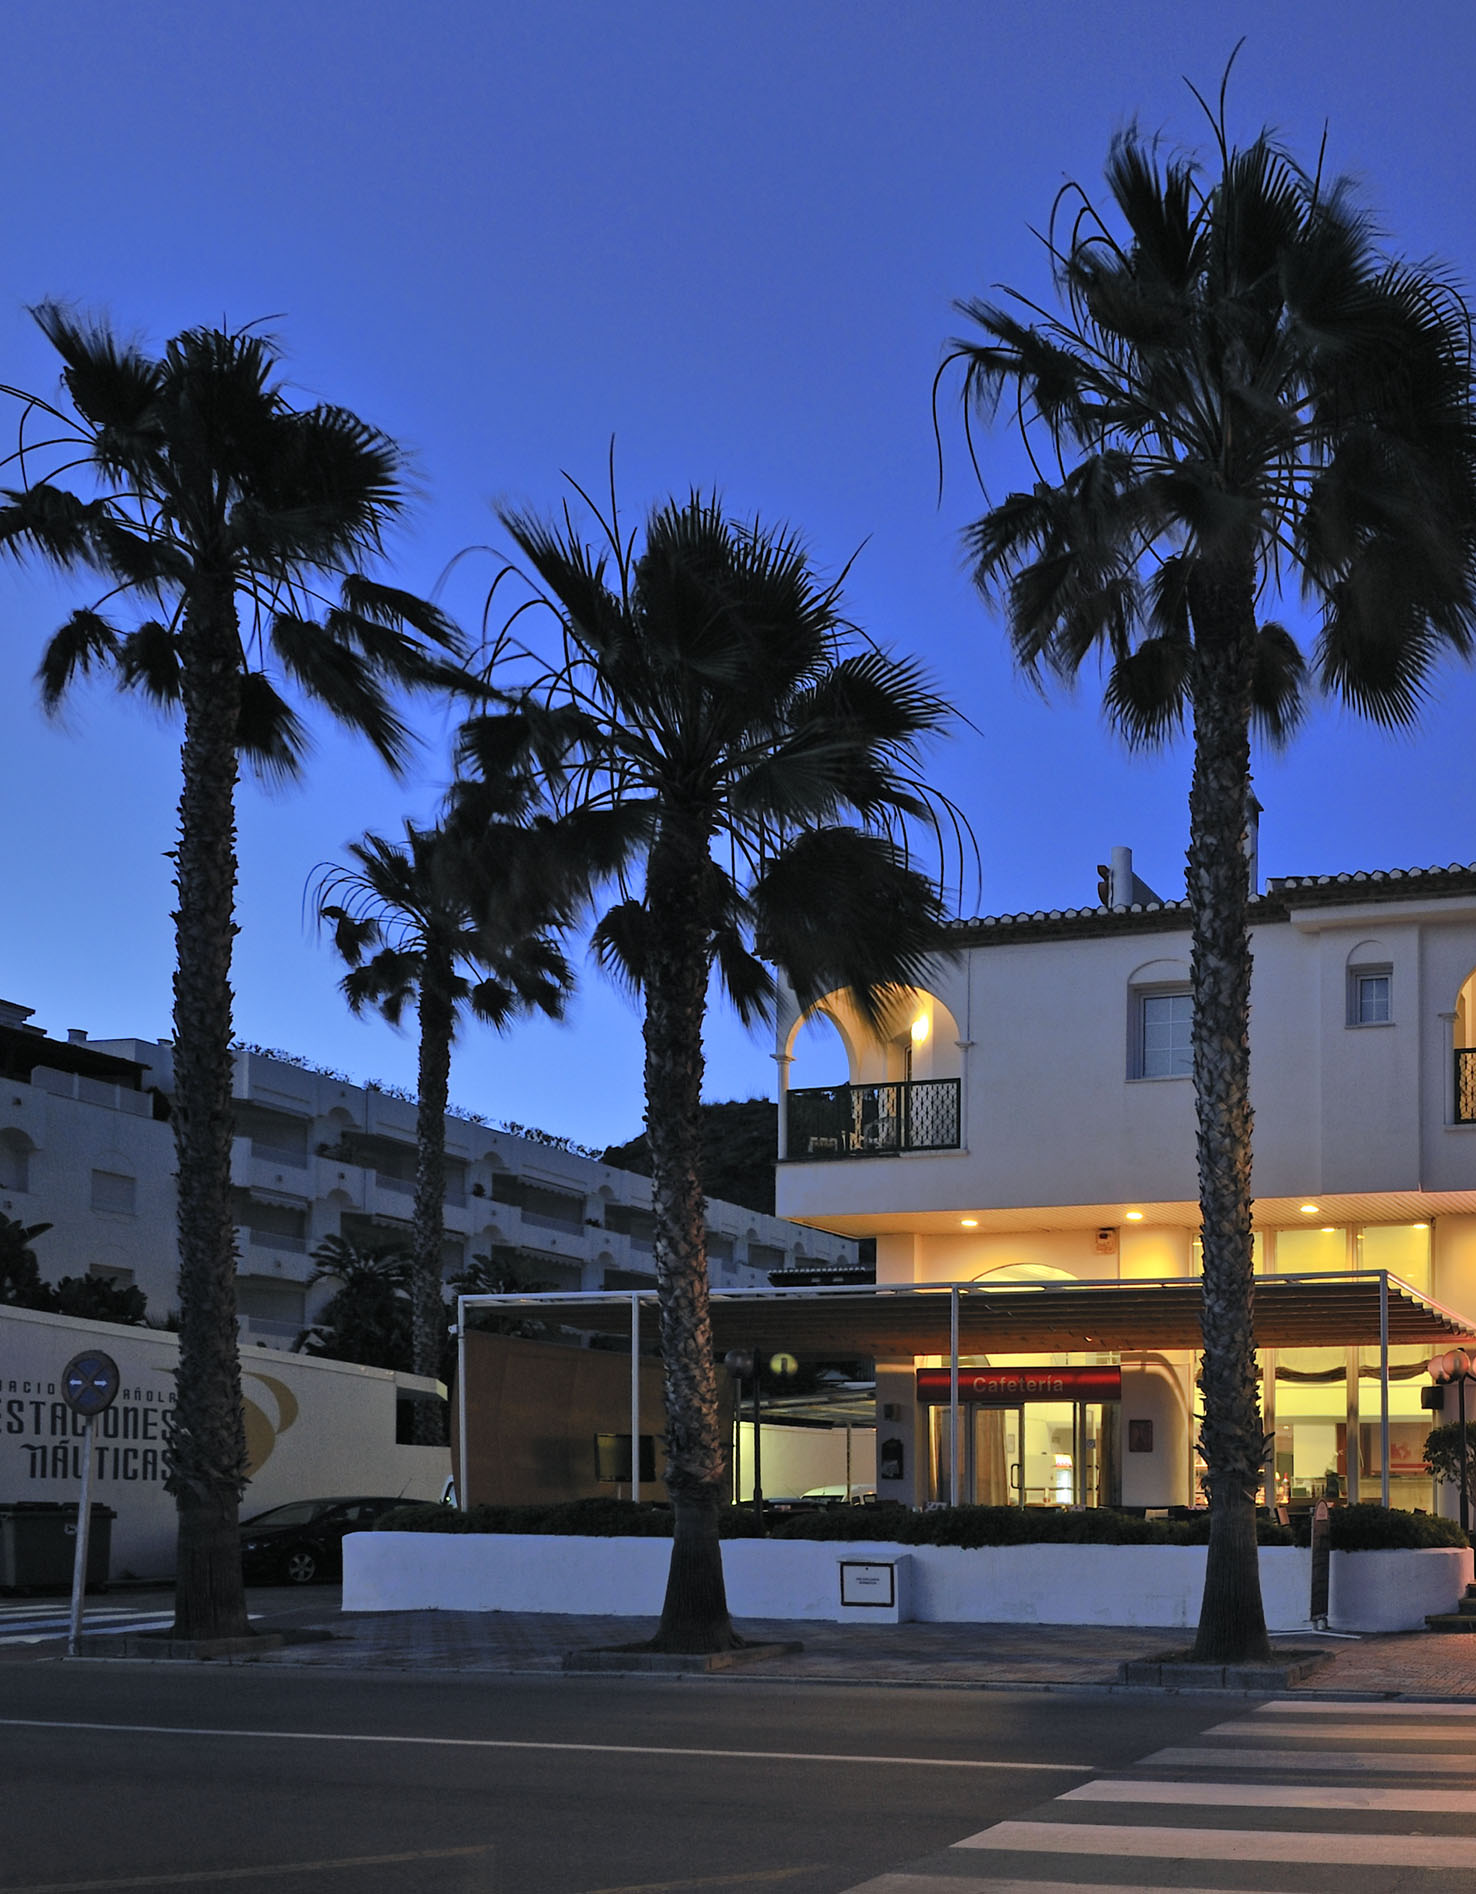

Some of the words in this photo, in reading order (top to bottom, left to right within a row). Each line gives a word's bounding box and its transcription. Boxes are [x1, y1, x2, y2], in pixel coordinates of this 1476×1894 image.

[0, 1379, 56, 1396] ACIO
[123, 1386, 177, 1403] AÑOLA
[973, 1375, 1064, 1393] Cafetería
[0, 1399, 175, 1440] STACONES
